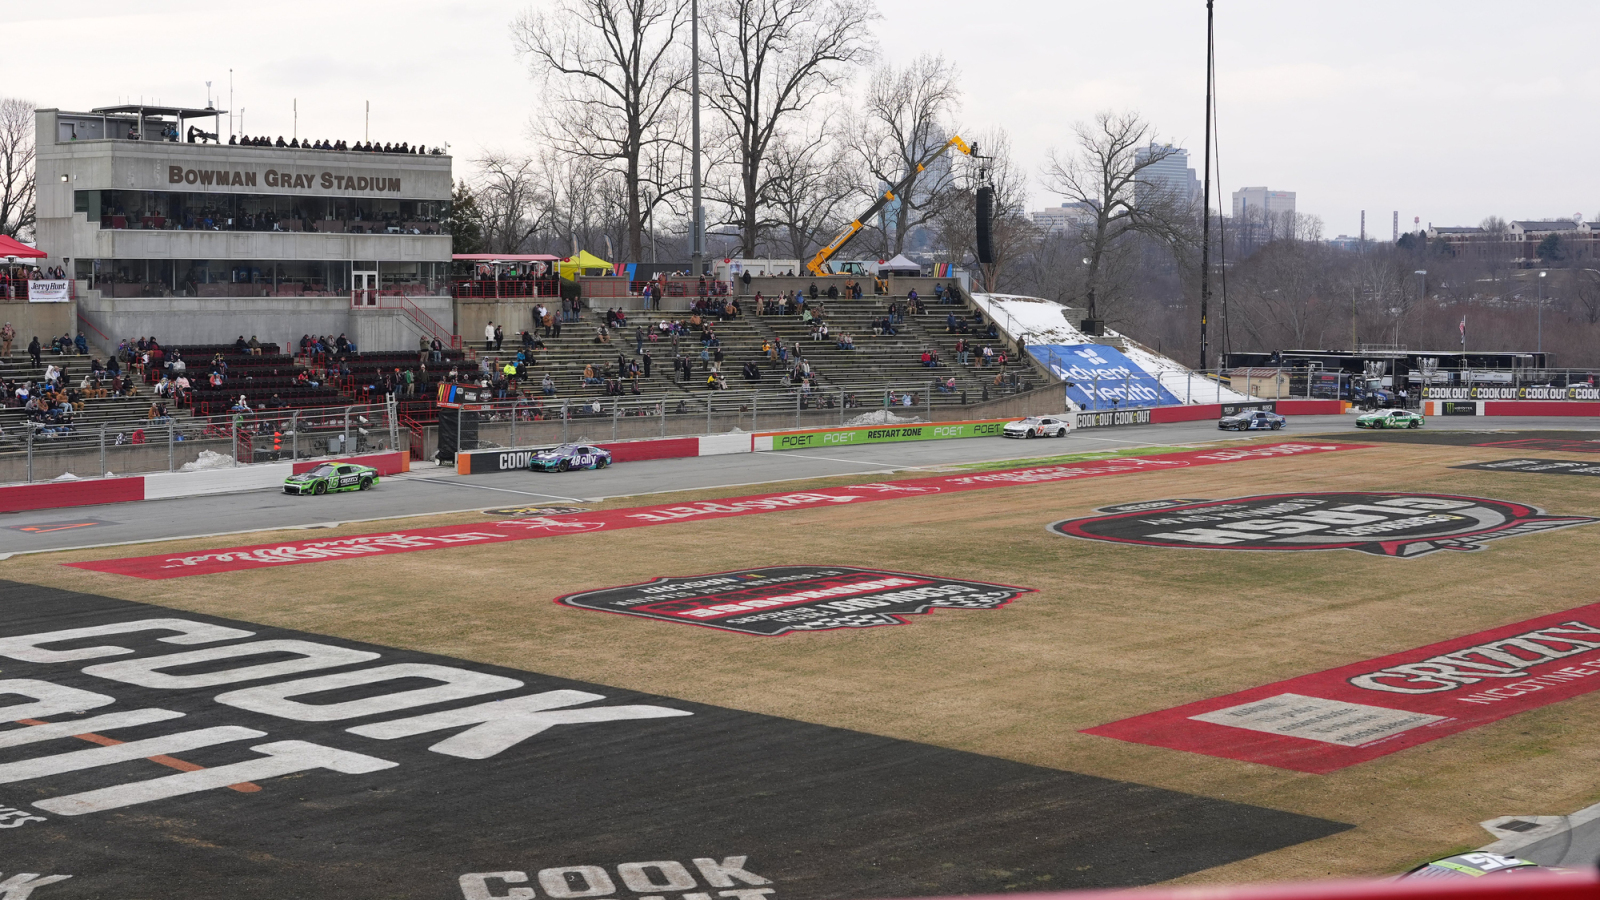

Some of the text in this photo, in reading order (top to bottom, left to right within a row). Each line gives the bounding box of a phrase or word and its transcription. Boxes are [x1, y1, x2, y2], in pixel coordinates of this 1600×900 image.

[168, 166, 400, 192] BOWMAN GRAY STADIUM
[31, 282, 66, 291] Jerry Hunt
[1051, 364, 1141, 380] Advent
[1076, 383, 1164, 401] Health
[1428, 388, 1469, 398] COOK OUT
[1476, 388, 1516, 398] COOK OUT
[1525, 388, 1566, 399] COOK OUT
[1575, 388, 1600, 399] COOK
[1077, 412, 1113, 427] COOK OUT
[1114, 410, 1150, 425] COOK OUT
[868, 428, 922, 439] RESTART ZONE
[934, 426, 964, 436] POET
[974, 424, 1000, 434] POET
[782, 435, 814, 446] POET
[824, 432, 856, 443] POET
[500, 452, 532, 470] COOK
[571, 456, 580, 466] 48
[581, 455, 596, 466] ally
[625, 493, 863, 522] TEXAS PETE
[1142, 498, 1476, 544] CLASH
[427, 532, 508, 542] LET
[637, 577, 739, 594] NASCAR
[676, 577, 918, 618] MADHOUSE
[1348, 620, 1600, 694] GRIZZLY
[0, 618, 695, 760] COOK
[1457, 666, 1600, 705] NICOTINE
[459, 856, 774, 900] COOK
